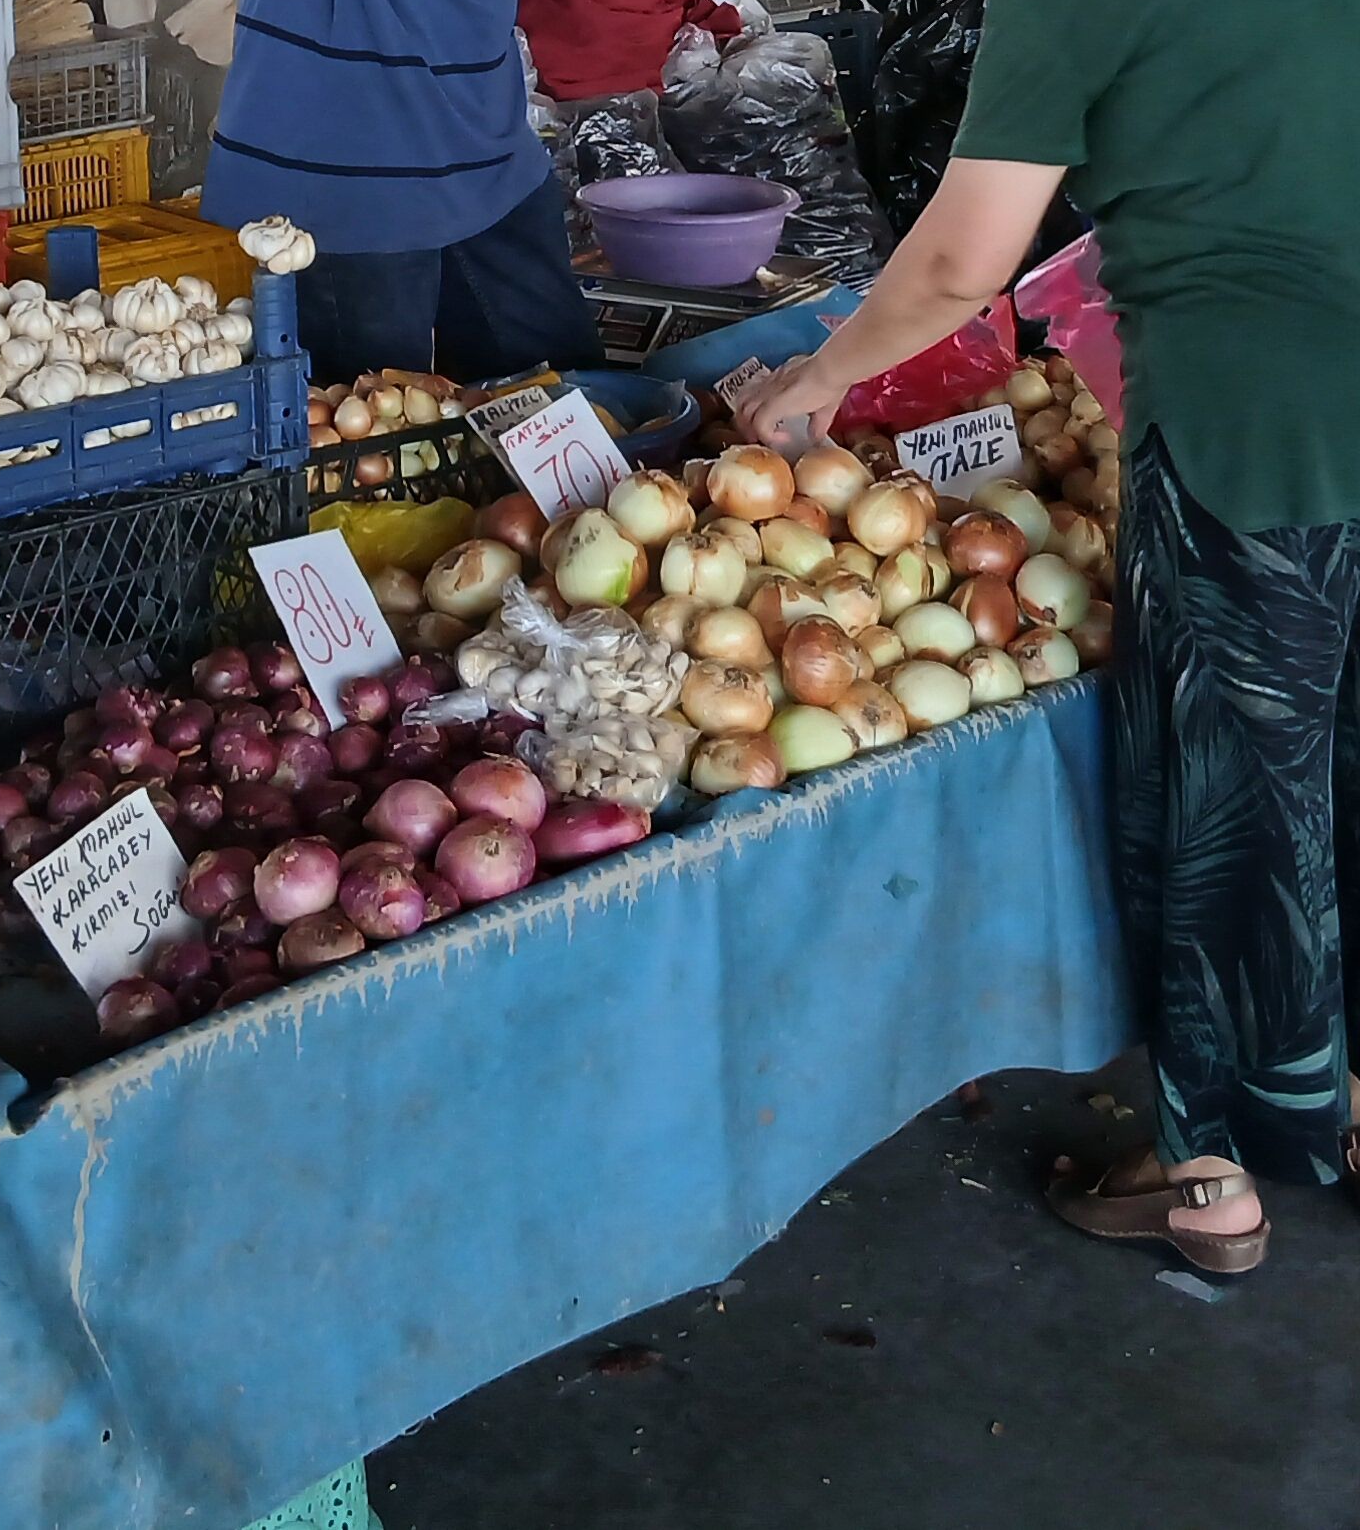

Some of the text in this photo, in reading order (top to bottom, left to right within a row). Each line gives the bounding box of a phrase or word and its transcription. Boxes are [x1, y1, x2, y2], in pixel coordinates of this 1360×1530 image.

[929, 436, 1004, 482] TAZE
[52, 828, 152, 927] KARACABEY
[71, 881, 136, 953] KIRMIZI
